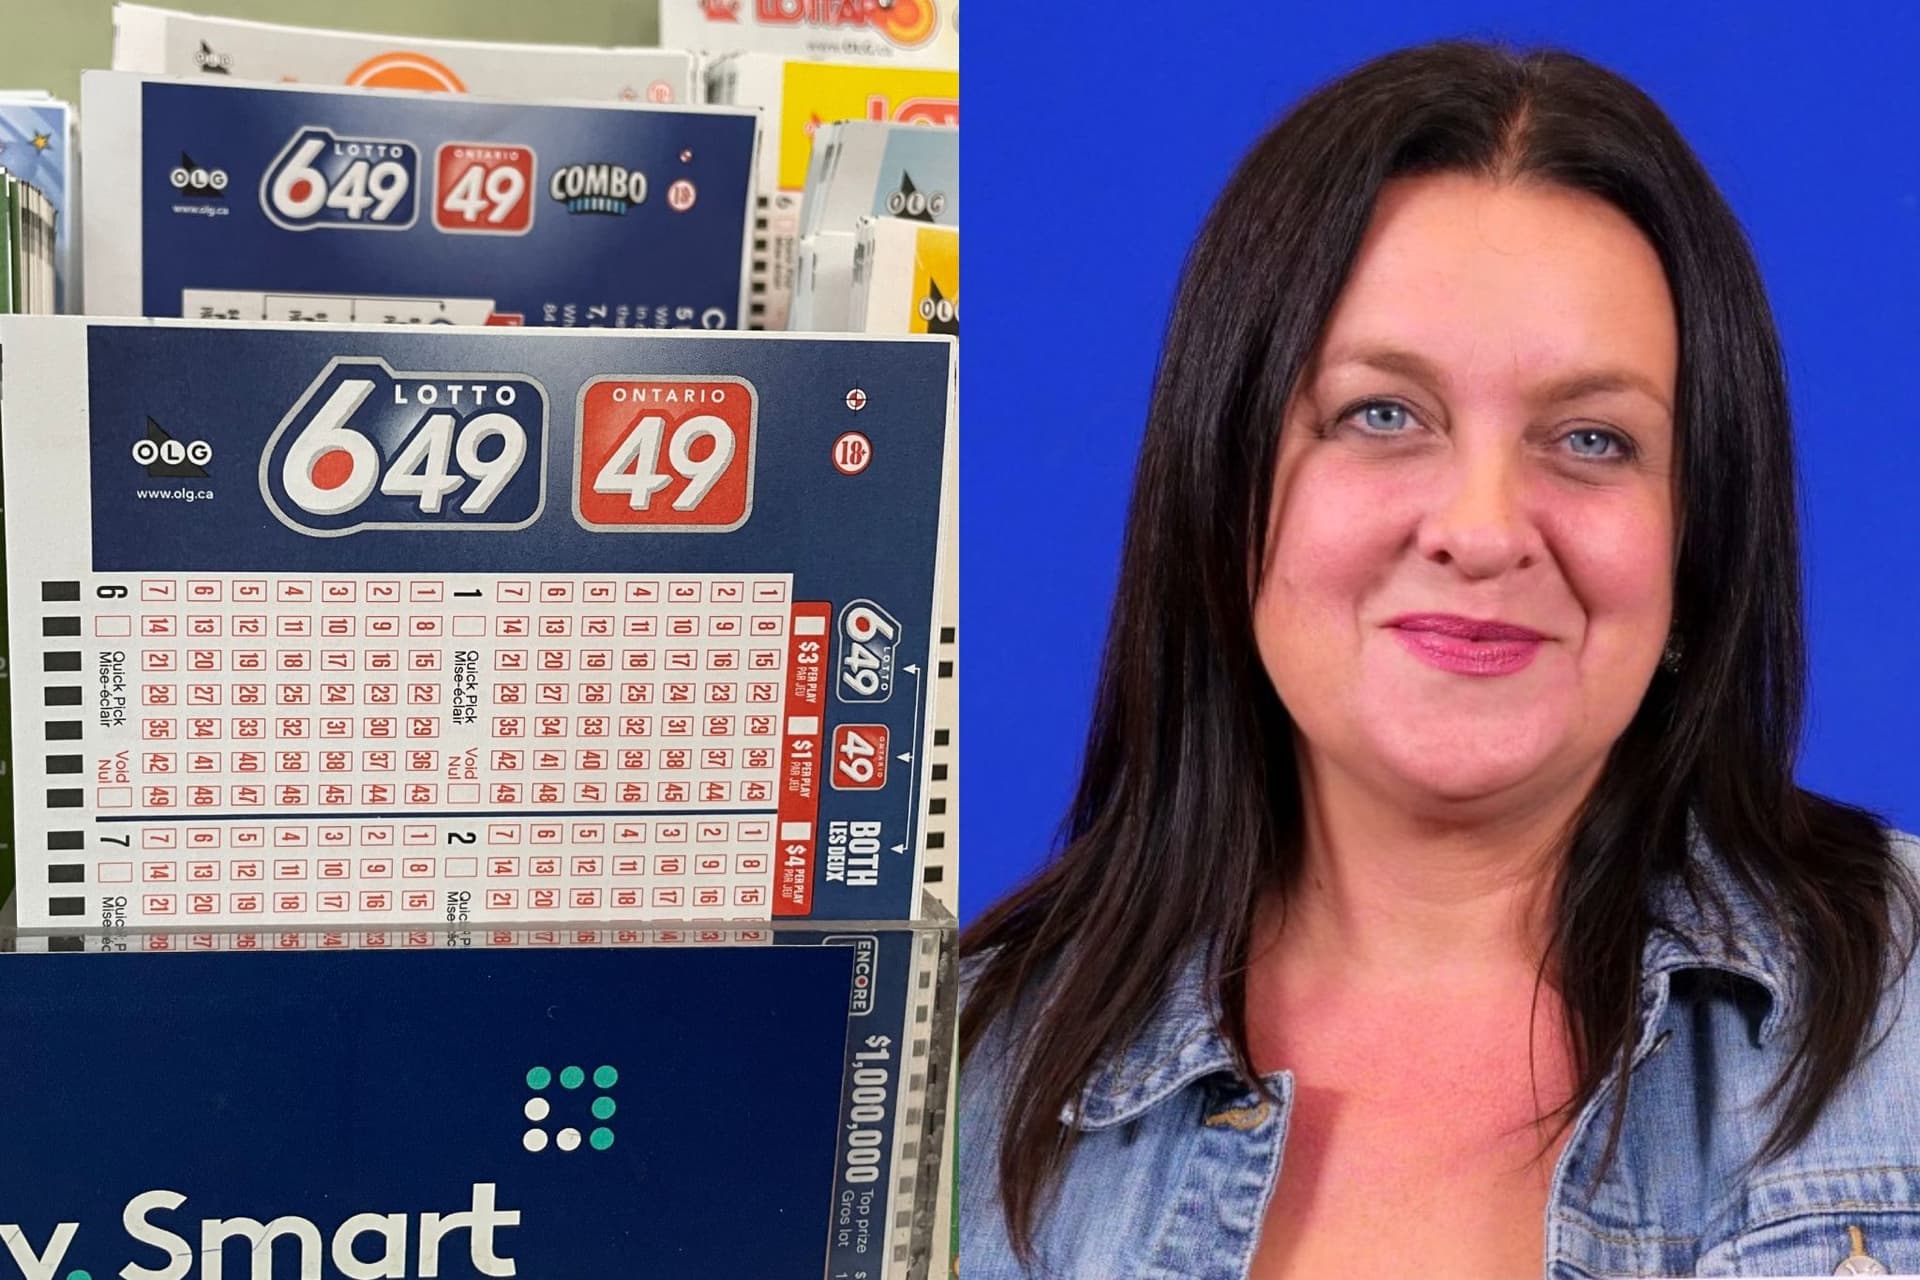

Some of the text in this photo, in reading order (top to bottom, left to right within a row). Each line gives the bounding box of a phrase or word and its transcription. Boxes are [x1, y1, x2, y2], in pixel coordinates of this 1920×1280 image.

[171, 168, 228, 189] OLG
[334, 143, 403, 158] LOTTO
[453, 148, 519, 161] ONTARIO
[443, 165, 525, 223] 49
[551, 164, 648, 204] COMBO
[888, 192, 945, 216] OLG
[920, 297, 959, 322] OL
[395, 384, 516, 406] LOTTO
[612, 387, 725, 403] ONTARIO
[132, 439, 213, 466] OLG
[593, 415, 736, 512] 49
[137, 487, 214, 502] www.olg.ca
[96, 585, 128, 599] 6
[453, 588, 483, 598] 1
[99, 651, 113, 728] Mise-éclair
[112, 650, 126, 726] Quick Pick
[148, 585, 169, 808] 7 14 21 28 35 42 49
[239, 585, 259, 804] 5 12 19 26 33 40 47
[326, 584, 348, 805] 3 10 17 24 31 38 45
[412, 587, 435, 804] 1 8 15 22 29 36 43
[452, 650, 466, 725] Mise-éclair
[465, 650, 479, 724] Quick Pick
[497, 587, 523, 804] 7 14 21 28 35 42 49
[583, 585, 608, 800] 5 12 19 26 33 40 47
[666, 586, 694, 802] 3 10 17 24 31 38 45
[748, 587, 777, 801] 1 8 15 22 29 36 43
[794, 666, 807, 697] PAR JEU
[797, 641, 820, 704] $3 PER PLAY
[880, 646, 891, 692] LOTTO
[97, 759, 112, 784] Nul
[115, 750, 130, 783] Void
[447, 756, 461, 780] Nul
[464, 747, 478, 780] Void
[788, 761, 801, 792] PAR JEU
[790, 739, 814, 798] $1 PER PLAY
[839, 730, 875, 783] 49
[876, 735, 885, 779] ONTARIO
[100, 834, 130, 848] 7
[447, 832, 476, 845] 2
[620, 828, 637, 906] 4 11 18
[826, 821, 848, 882] LES DEUX
[847, 821, 882, 886] BOTH
[194, 832, 212, 914] 6 13 20
[324, 831, 343, 912] 3 10 17
[409, 831, 430, 908] 1 8 15
[536, 828, 555, 910] 6 13 20
[781, 868, 794, 899] PAR JEU
[784, 844, 807, 905] $4 PER PLAY
[853, 940, 872, 1010] ENCORE
[845, 1034, 891, 1184] $1,000,000
[119, 1183, 521, 1280] Smart
[838, 1189, 855, 1247] Gros lot
[855, 1188, 874, 1254] Top prize
